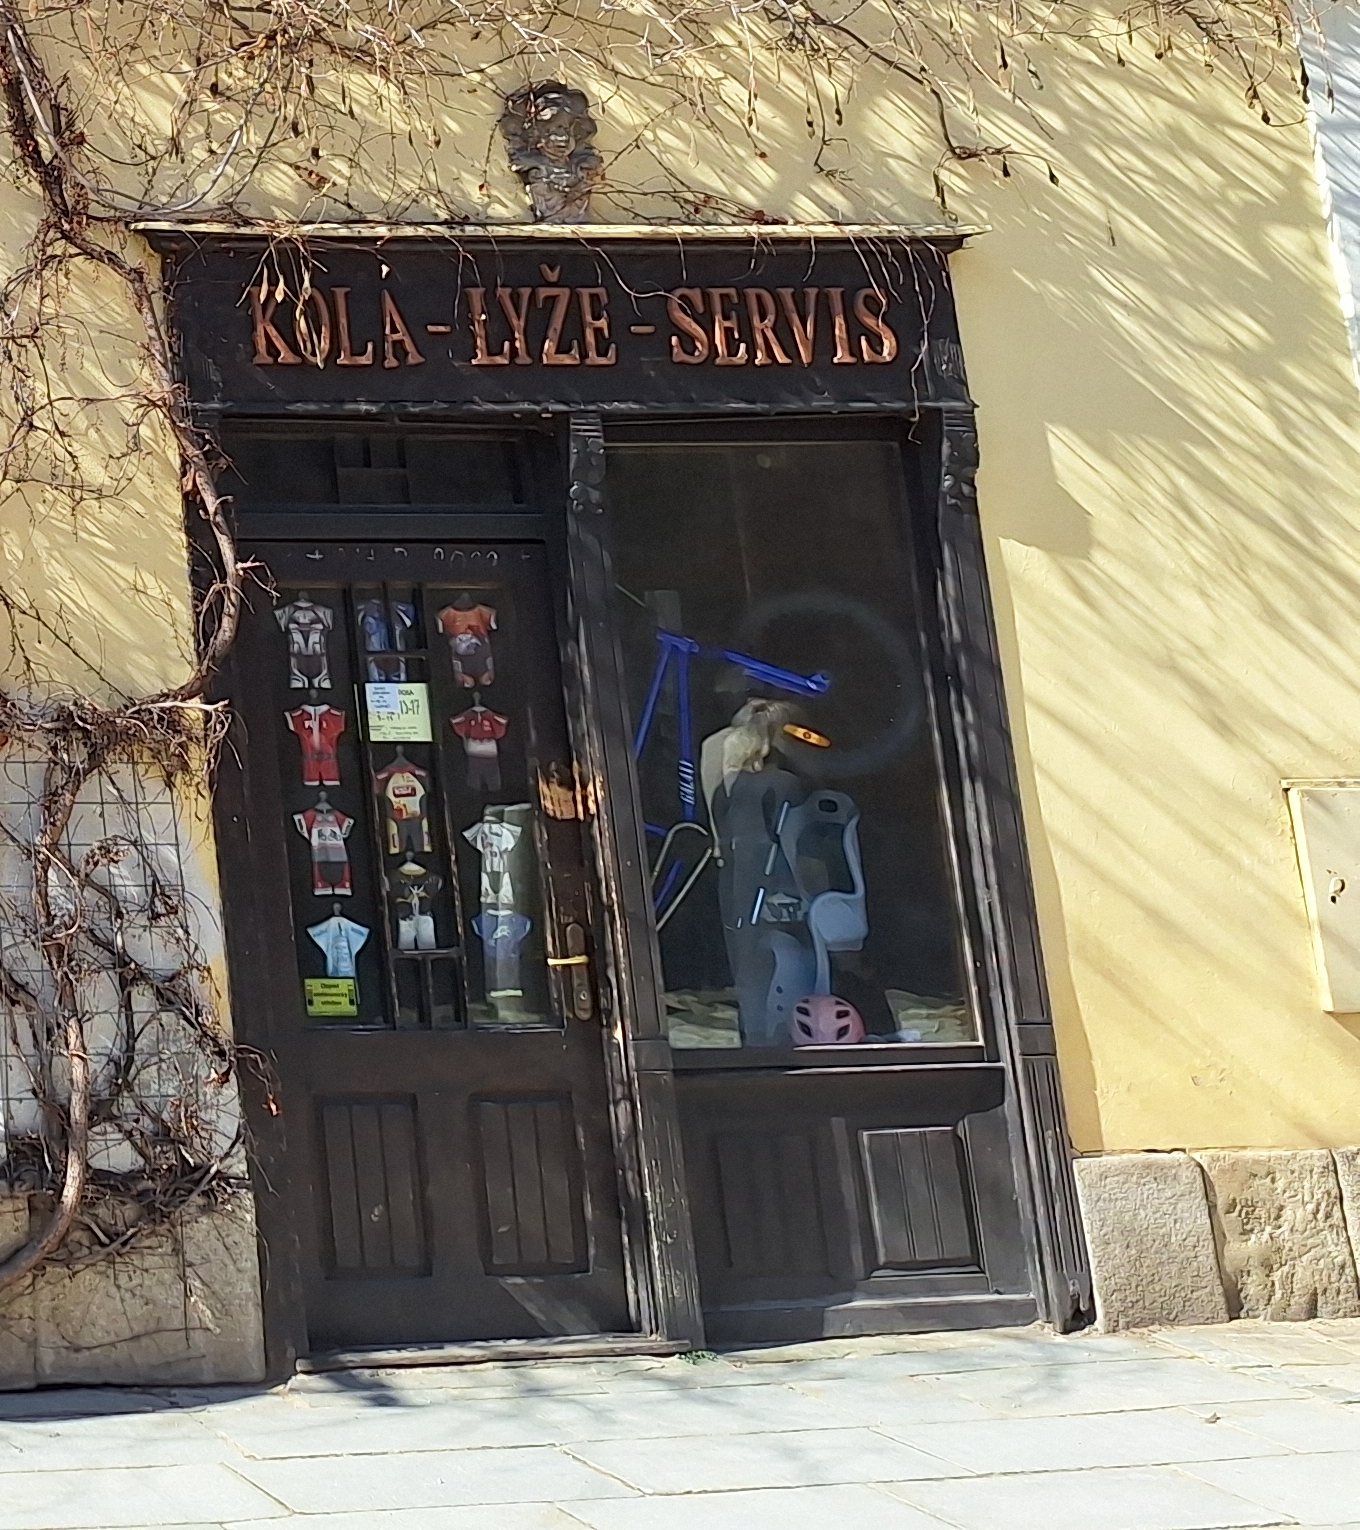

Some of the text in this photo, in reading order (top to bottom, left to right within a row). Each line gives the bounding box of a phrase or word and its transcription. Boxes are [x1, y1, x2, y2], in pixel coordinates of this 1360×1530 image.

[251, 284, 426, 369] KOLA
[469, 264, 618, 367] LYŽE
[670, 286, 899, 367] SERVIS
